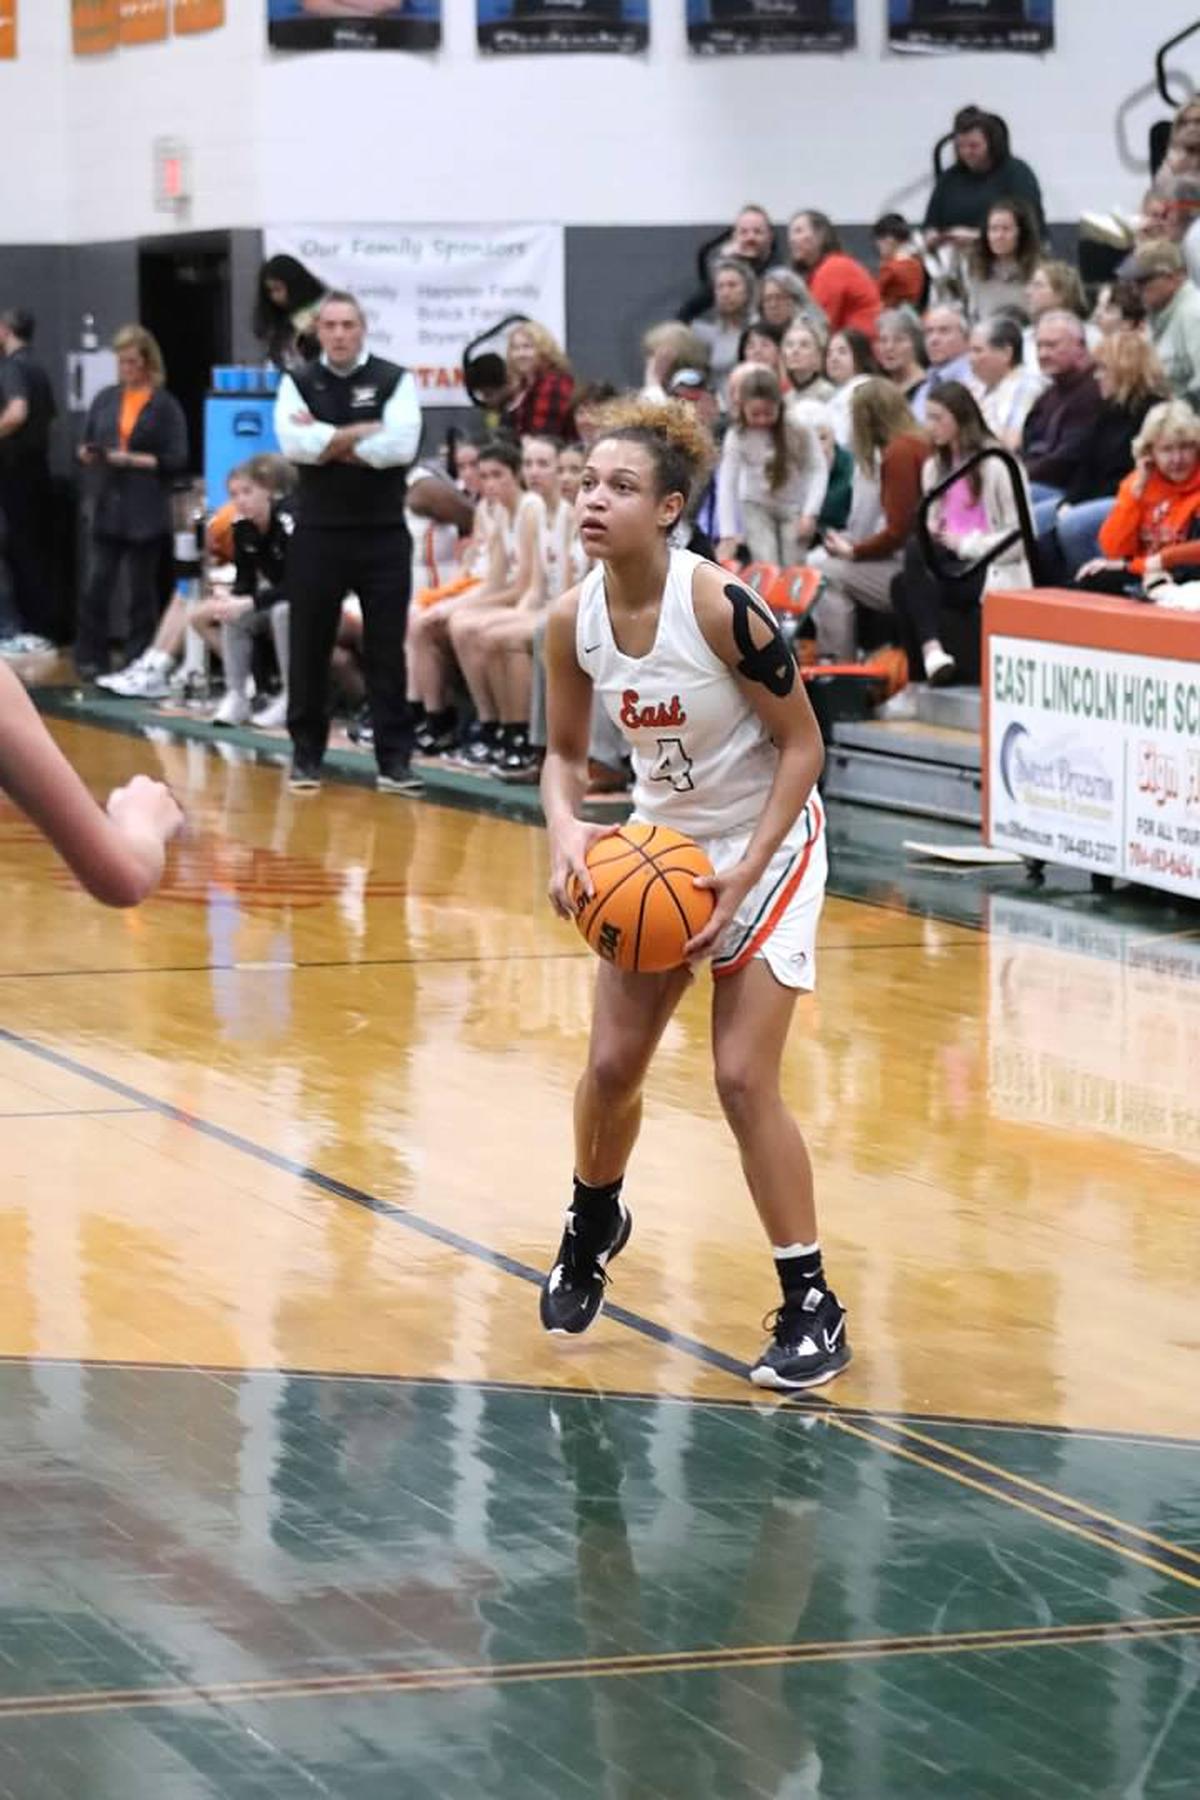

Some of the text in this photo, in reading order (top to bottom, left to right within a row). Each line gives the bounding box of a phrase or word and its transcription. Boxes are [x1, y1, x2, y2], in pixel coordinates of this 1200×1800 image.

[300, 237, 527, 265] Our Family Sponsors
[621, 689, 686, 728] East
[995, 655, 1200, 736] EAST LINCOLN HIGH SC
[650, 738, 694, 791] 4
[1137, 817, 1155, 836] FOR
[1157, 821, 1174, 841] ALL
